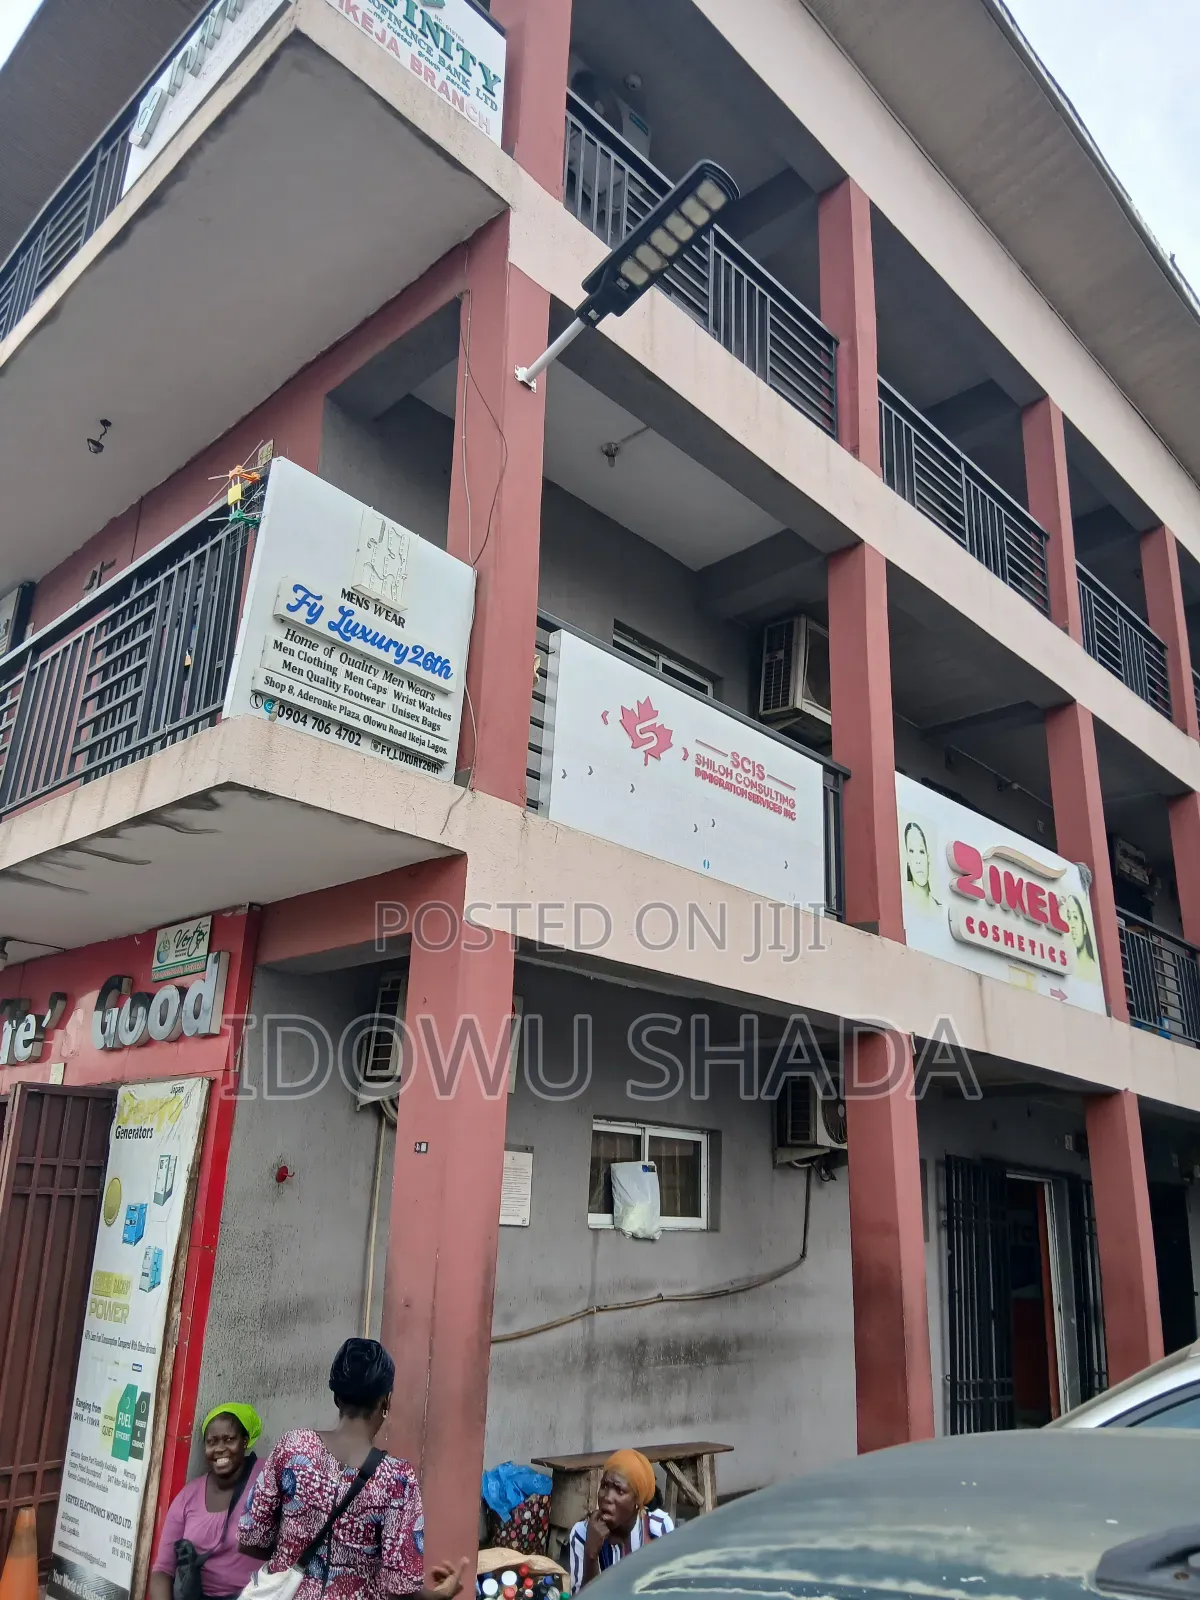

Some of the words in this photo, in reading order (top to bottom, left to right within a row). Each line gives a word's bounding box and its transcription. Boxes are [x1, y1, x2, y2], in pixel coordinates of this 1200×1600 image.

[338, 0, 400, 59] IKEJA
[410, 53, 492, 135] BRANCH
[418, 50, 441, 72] growth
[438, 53, 471, 90] BANK
[475, 86, 499, 112] LTD
[286, 583, 324, 625] Fy
[327, 605, 454, 680] Luxury26th
[373, 604, 406, 629] WEAR
[272, 639, 295, 657] Men
[297, 650, 339, 677] Clothing
[344, 669, 365, 686] Men
[366, 679, 388, 696] Caps
[393, 690, 417, 709] Wrist
[418, 700, 452, 722] Watches
[284, 628, 319, 652] Home
[323, 645, 336, 659] of
[339, 651, 380, 677] Quality
[382, 670, 405, 689] Men
[407, 680, 436, 701] Wears
[264, 675, 286, 694] Shop
[296, 688, 338, 712] Aderonke
[362, 715, 387, 732] Olowu
[388, 721, 407, 739] Road
[408, 727, 426, 749] Ikeja
[281, 659, 304, 677] Men
[306, 669, 342, 693] Quality
[343, 683, 386, 709] Footwear
[391, 703, 420, 724] Unisex
[421, 716, 442, 732] Bags
[277, 704, 308, 727] 0904
[311, 716, 332, 735] 706
[335, 725, 362, 747] 4702
[695, 753, 734, 780] SHILOH
[735, 772, 796, 809] CONSULTING
[730, 751, 766, 781] SCIS
[694, 767, 748, 799] IMMIGRATION
[747, 791, 783, 815] SERVICES
[783, 807, 797, 821] INC
[950, 840, 1070, 934] ZIKEL
[965, 916, 1067, 966] COSMETICS
[91, 975, 231, 1051] Good
[115, 1125, 154, 1140] Generators
[89, 1298, 130, 1324] POWER
[75, 1397, 92, 1413] Ranging
[92, 1402, 102, 1414] from
[118, 1412, 131, 1428] FUEL
[106, 1509, 122, 1526] WORLD
